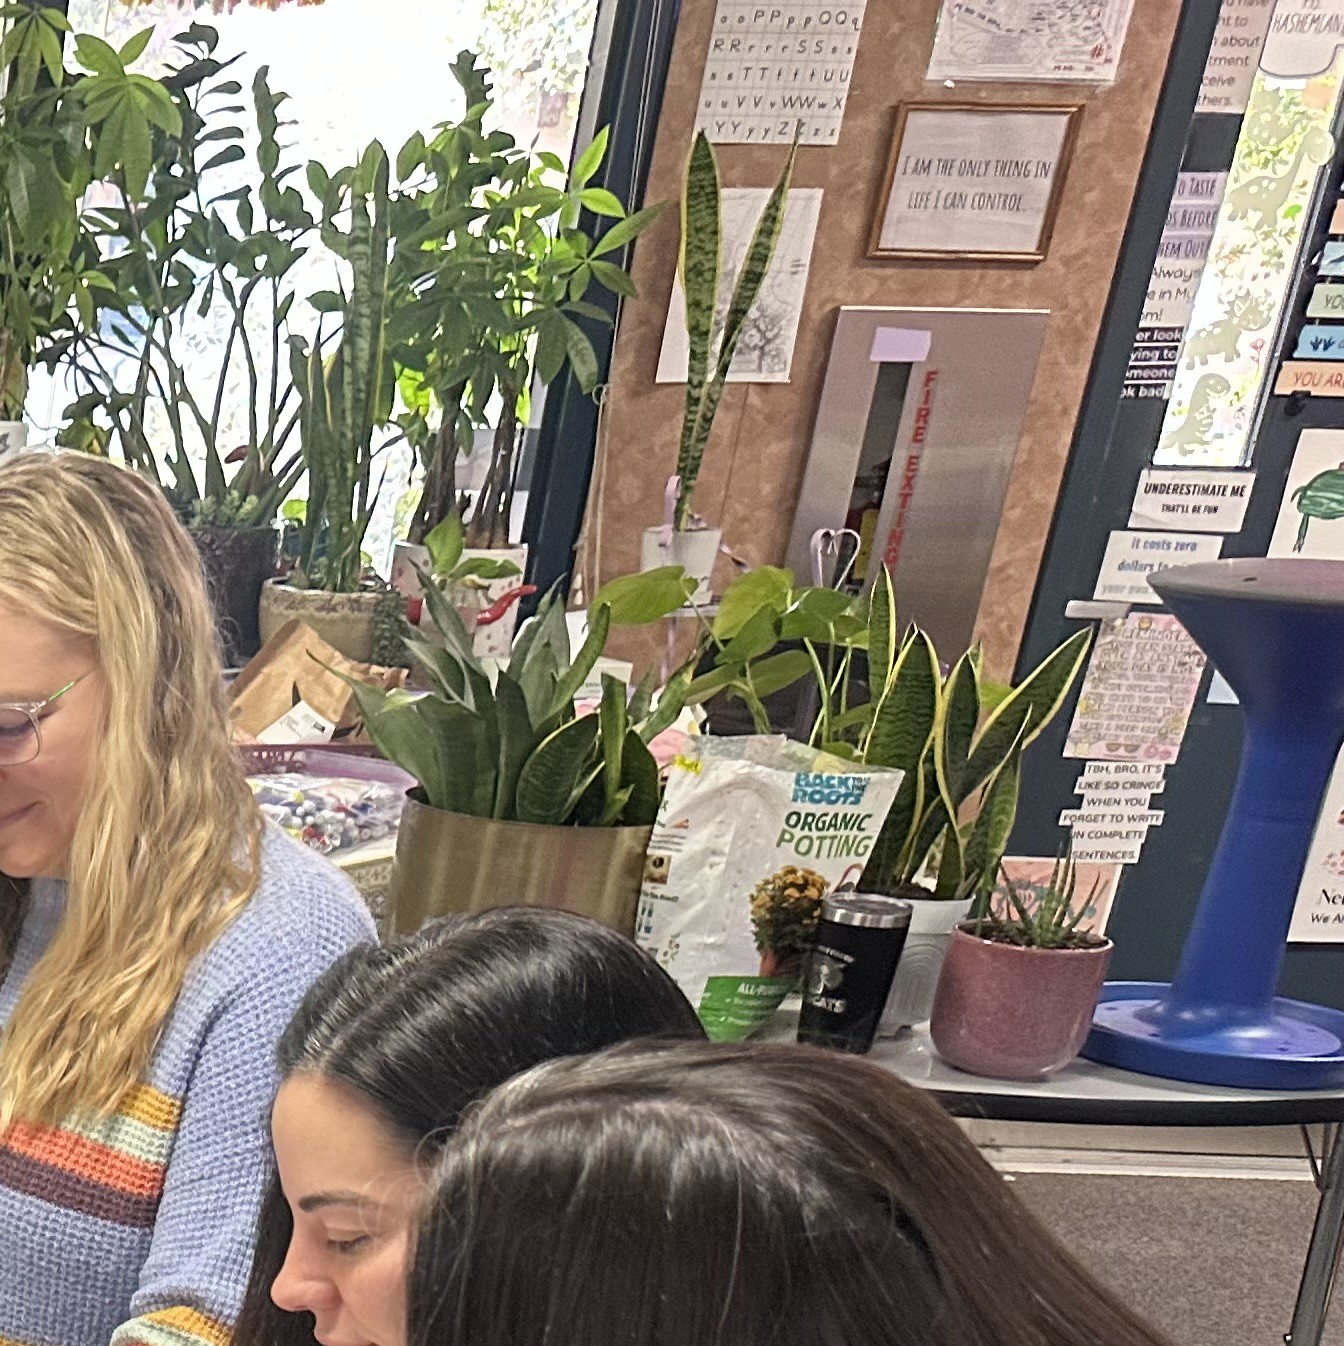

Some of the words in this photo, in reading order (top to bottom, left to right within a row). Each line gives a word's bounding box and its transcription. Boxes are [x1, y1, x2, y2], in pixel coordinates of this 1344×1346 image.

[1220, 33, 1261, 48] about
[902, 155, 912, 176] I
[912, 158, 933, 177] AM
[936, 158, 956, 177] THE
[958, 158, 991, 178] ONLY
[993, 158, 1032, 179] THING
[1033, 160, 1053, 179] IN
[907, 190, 932, 210] LIFE
[933, 188, 945, 210] I
[943, 190, 969, 210] CAN
[1153, 327, 1181, 342] look
[1293, 372, 1322, 388] YOU
[912, 370, 938, 443] FIRE
[1143, 482, 1229, 498] UNDERESTIMATE
[1229, 484, 1247, 498] ME
[1173, 541, 1198, 551] zero
[1141, 763, 1163, 774] IT'S
[794, 771, 853, 790] BACK
[1077, 780, 1102, 790] LIKE
[1103, 780, 1121, 790] SO
[1121, 780, 1162, 791] CRINGE
[791, 787, 862, 806] ROOTS
[1086, 797, 1121, 807] WHEN
[1123, 797, 1147, 807] YOU
[784, 810, 873, 833] ORGANIC
[1063, 813, 1106, 824] FORGET
[1108, 813, 1124, 824] TO
[1126, 814, 1162, 824] WRITE
[1087, 830, 1144, 840] COMPLETE
[775, 828, 874, 860] POTTING
[1311, 912, 1330, 924] We
